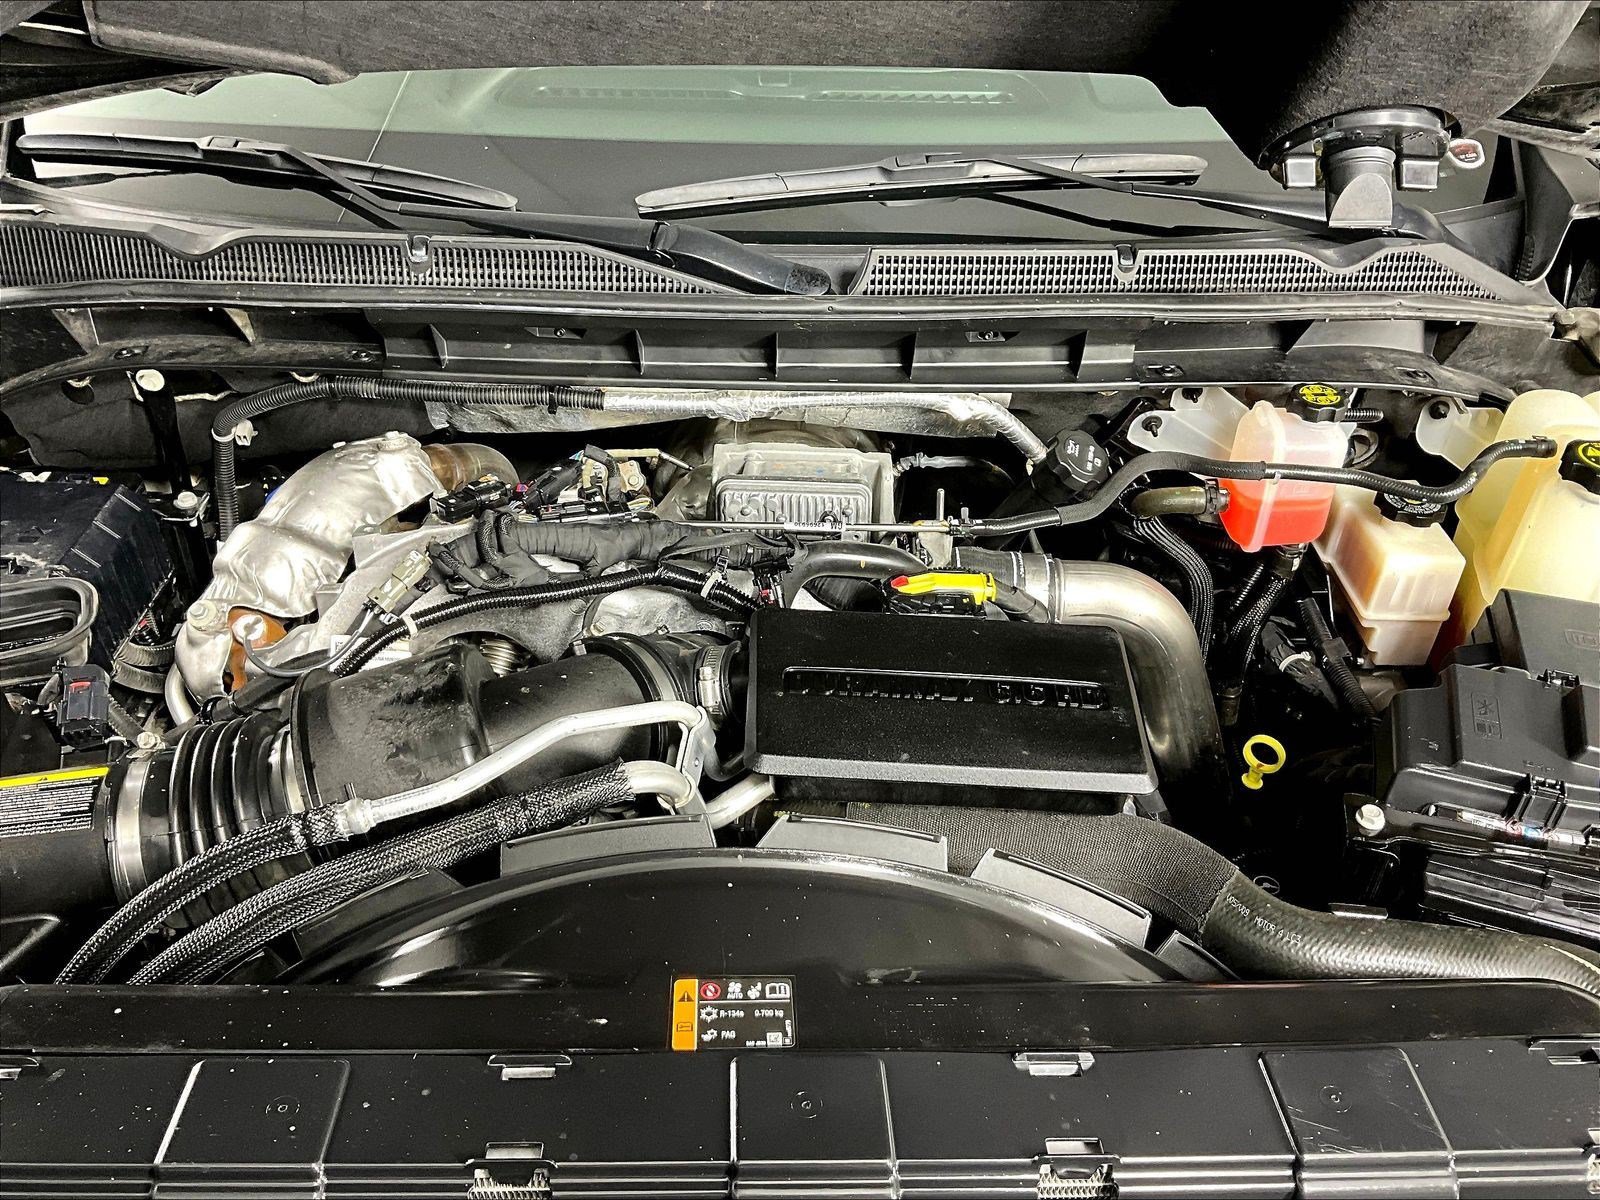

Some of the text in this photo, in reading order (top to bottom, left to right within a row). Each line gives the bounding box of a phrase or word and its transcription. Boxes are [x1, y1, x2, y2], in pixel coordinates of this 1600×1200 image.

[1254, 916, 1276, 933] MOTOR
[726, 992, 744, 1000] AUTO
[721, 1030, 736, 1040] PAG
